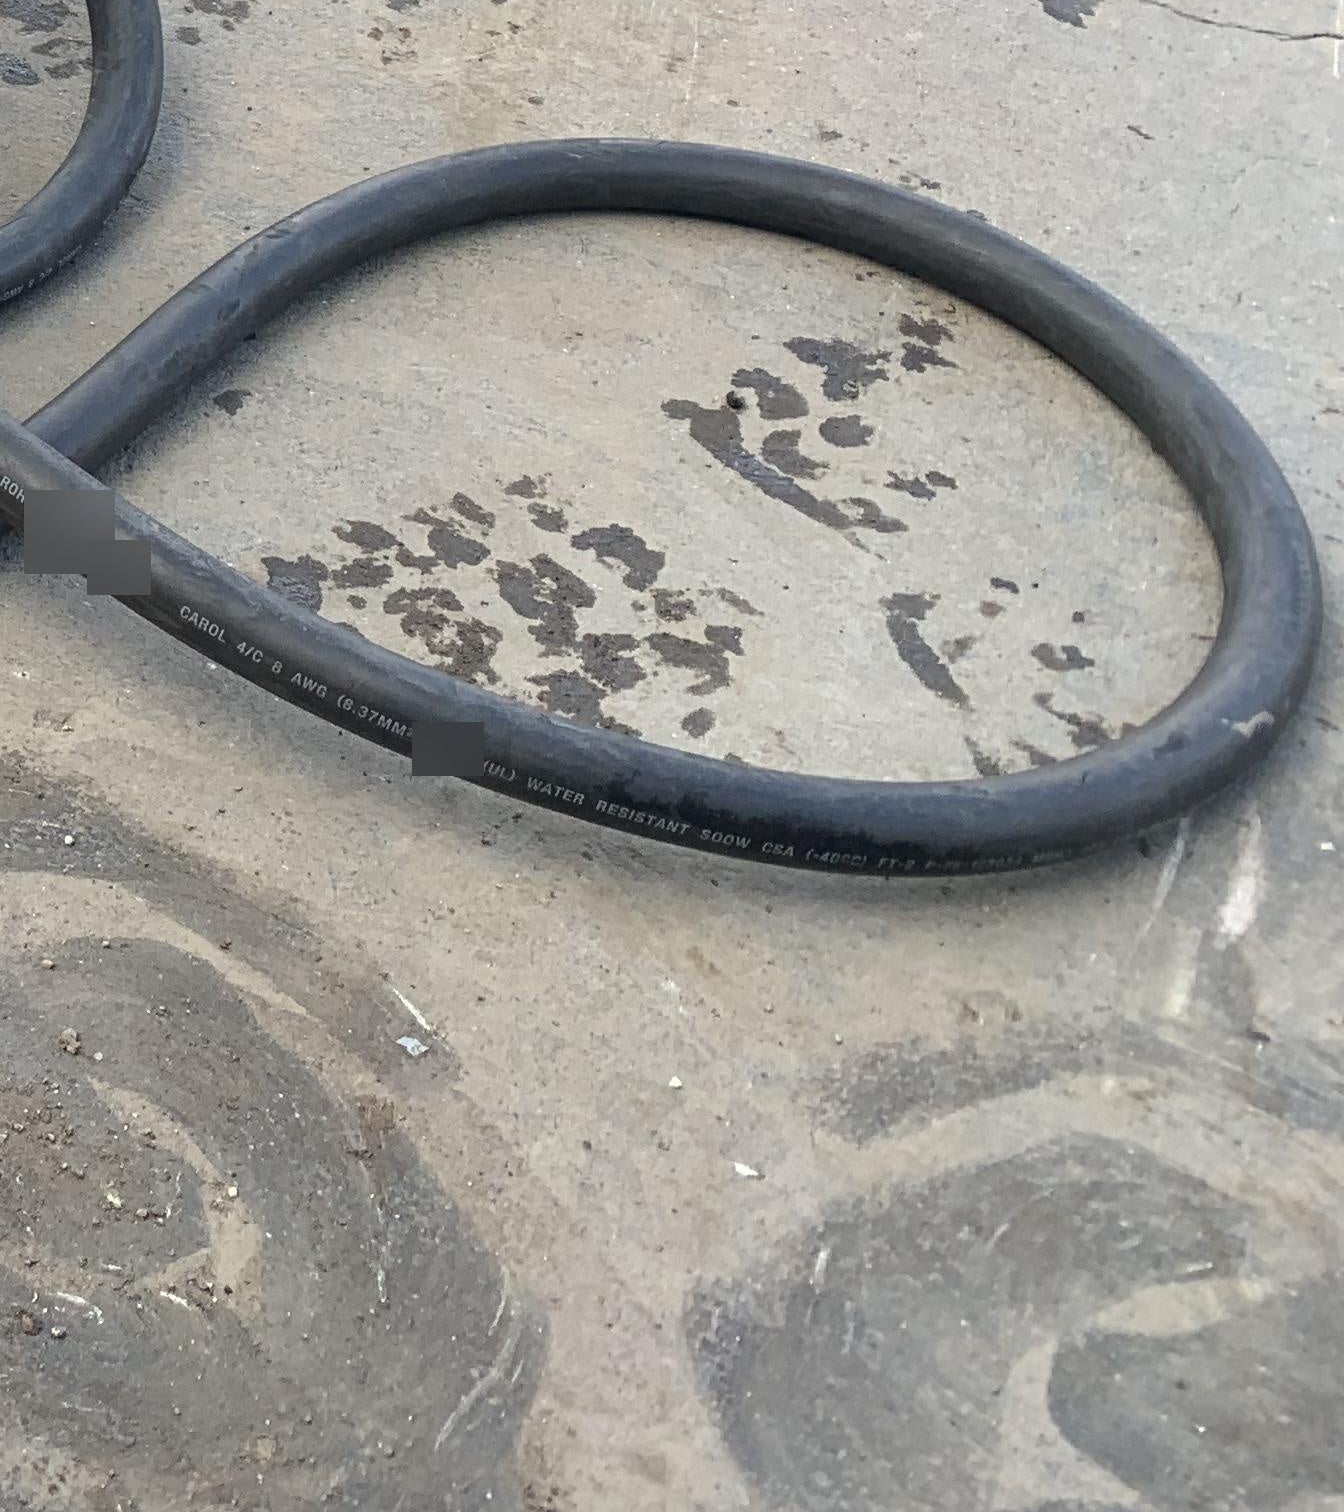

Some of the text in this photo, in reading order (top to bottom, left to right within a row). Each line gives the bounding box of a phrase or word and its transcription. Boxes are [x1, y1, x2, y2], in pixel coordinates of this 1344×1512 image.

[0, 475, 25, 504] ROH
[179, 604, 227, 644] CAROL
[235, 640, 264, 666] 4/C
[271, 659, 284, 675] 8
[290, 671, 329, 700] AWG
[483, 759, 517, 782] (UL)
[526, 776, 585, 805] WATER
[595, 799, 691, 836] RESISTANT
[761, 841, 795, 857] CSA
